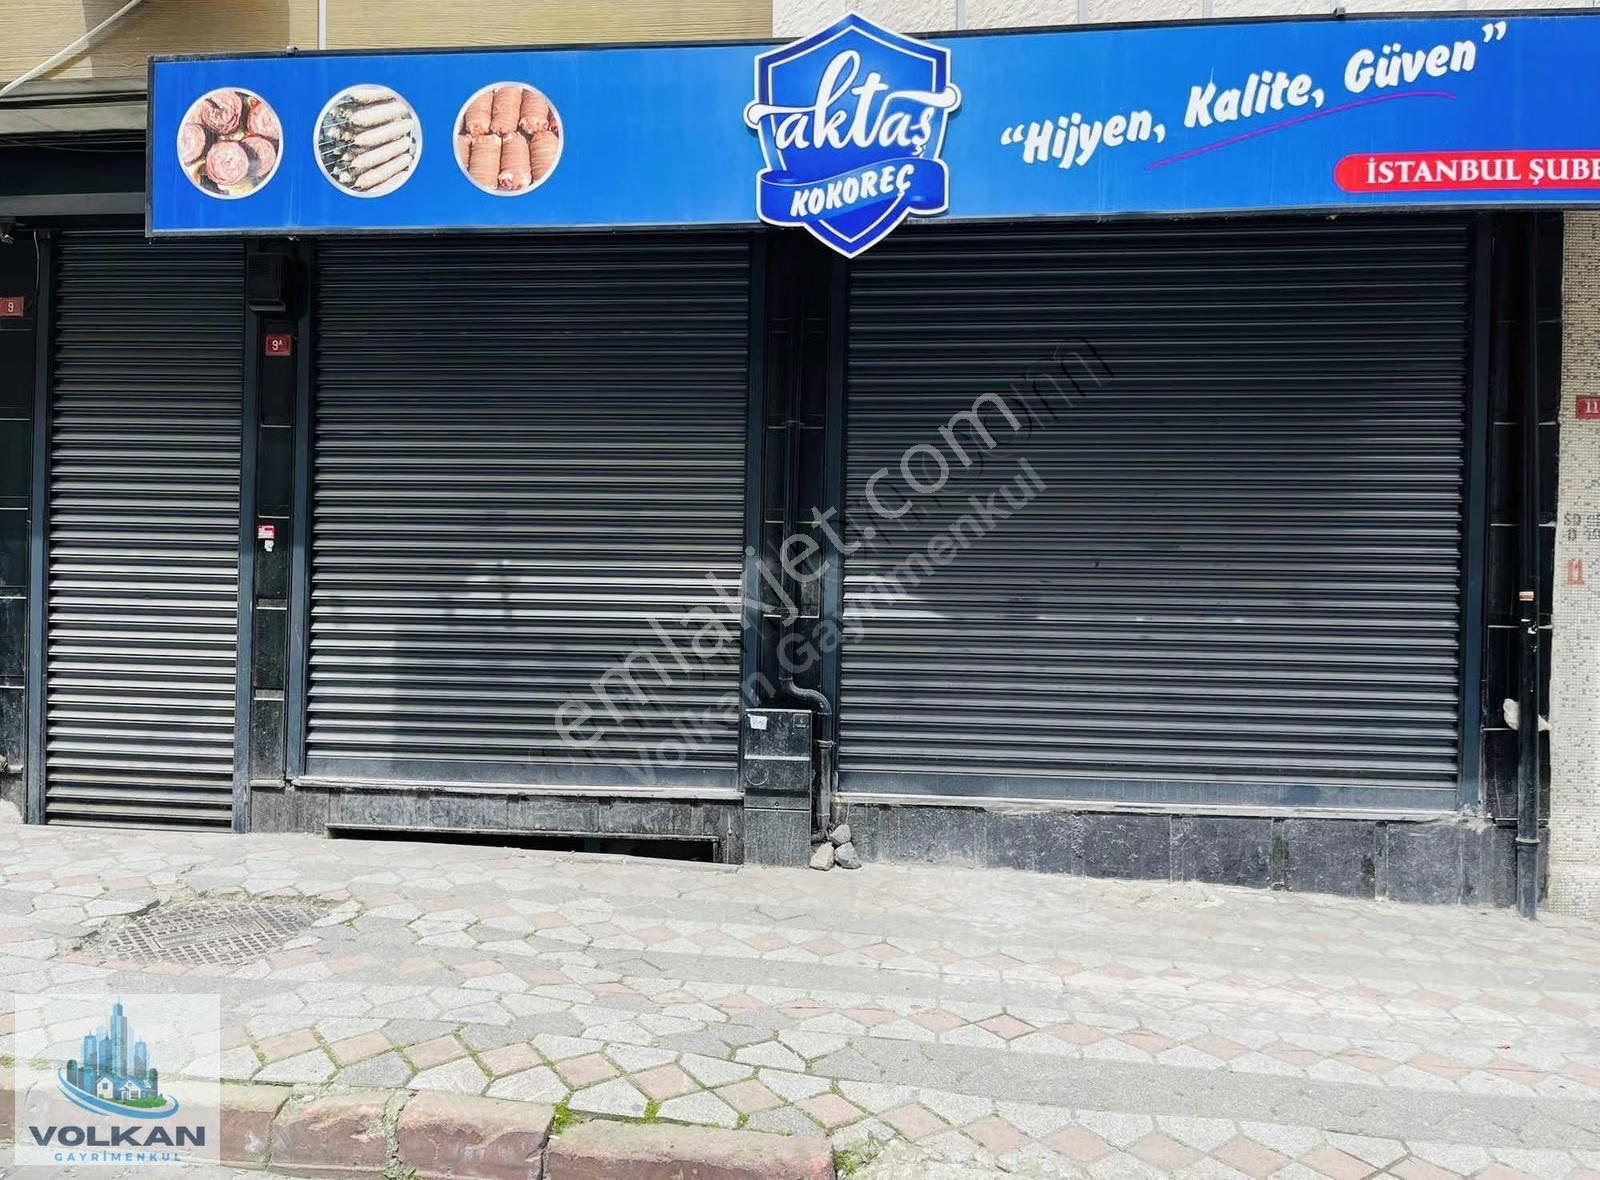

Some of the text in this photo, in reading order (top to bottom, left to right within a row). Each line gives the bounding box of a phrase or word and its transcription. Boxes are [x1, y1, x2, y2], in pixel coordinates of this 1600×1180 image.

[747, 50, 957, 156] aktaş
[1183, 70, 1325, 128] Kalite,
[790, 164, 915, 217] KOKOREÇ
[1366, 157, 1521, 184] İSTANBUL
[8, 302, 14, 313] 9
[1585, 401, 1599, 414] 11
